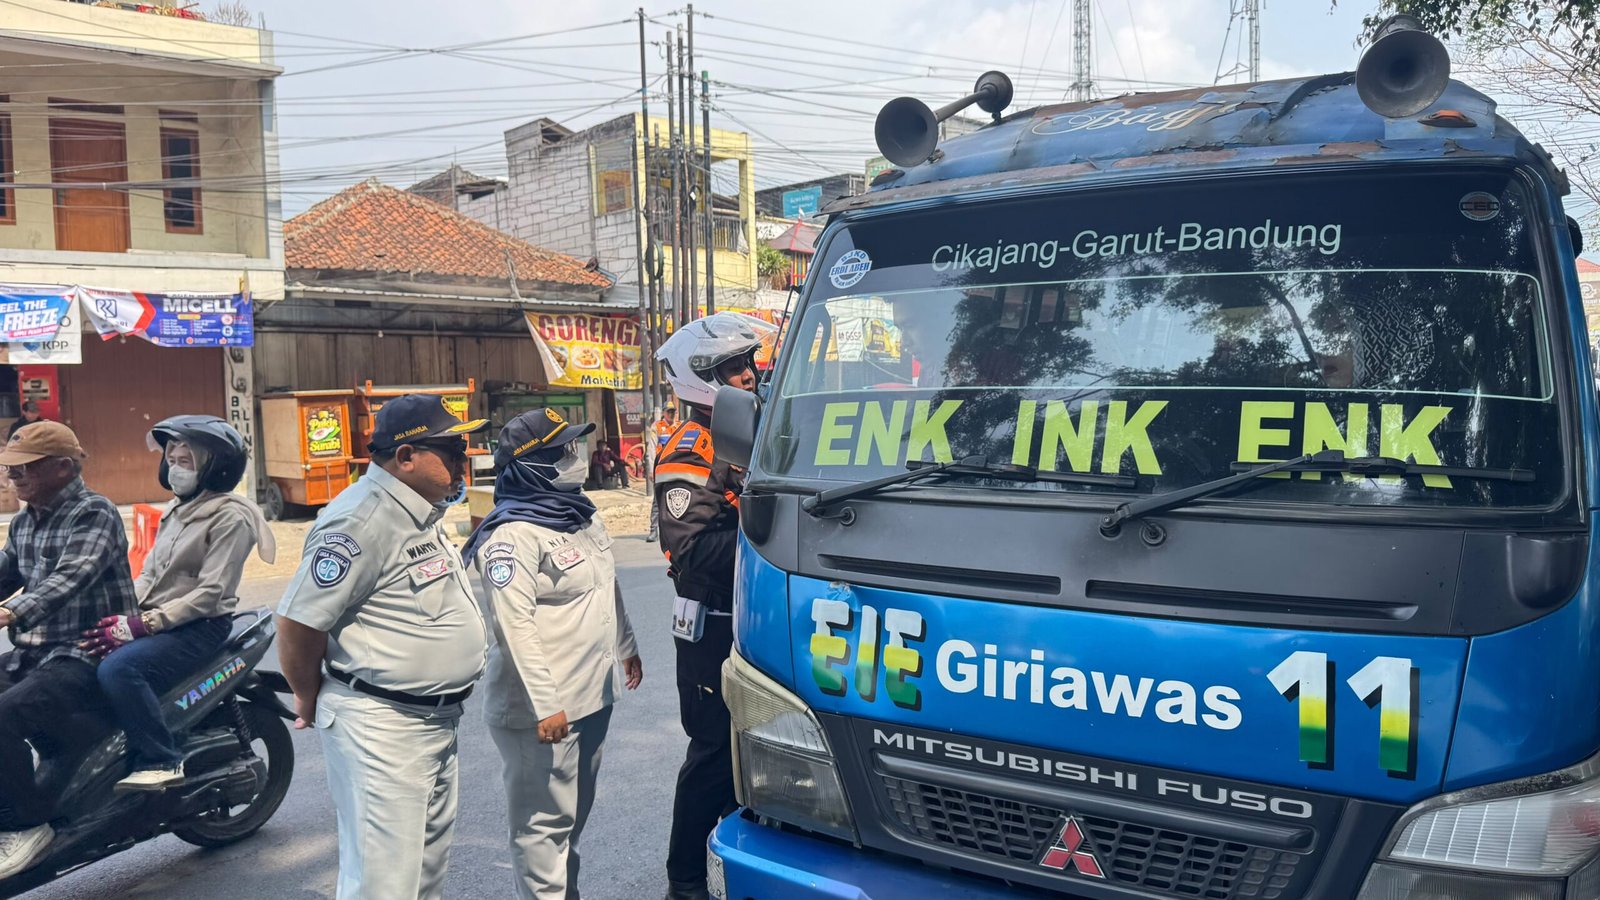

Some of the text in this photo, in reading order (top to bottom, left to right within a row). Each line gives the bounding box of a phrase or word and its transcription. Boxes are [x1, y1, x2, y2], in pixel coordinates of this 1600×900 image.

[931, 219, 1343, 273] Cikajang-Garut-Bandung
[0, 299, 48, 314] EEL THE
[163, 298, 237, 313] MICELL
[3, 308, 59, 332] FREEZE
[42, 340, 69, 350] KPP
[814, 399, 1456, 490] ENK INK ENK
[406, 541, 437, 559] WAHYU
[548, 536, 568, 548] NIA
[175, 657, 246, 710] YAMAHA
[936, 638, 1243, 731] Giriawas
[1266, 650, 1415, 773] 11
[873, 728, 1314, 819] MITSUBISHI FUSO
